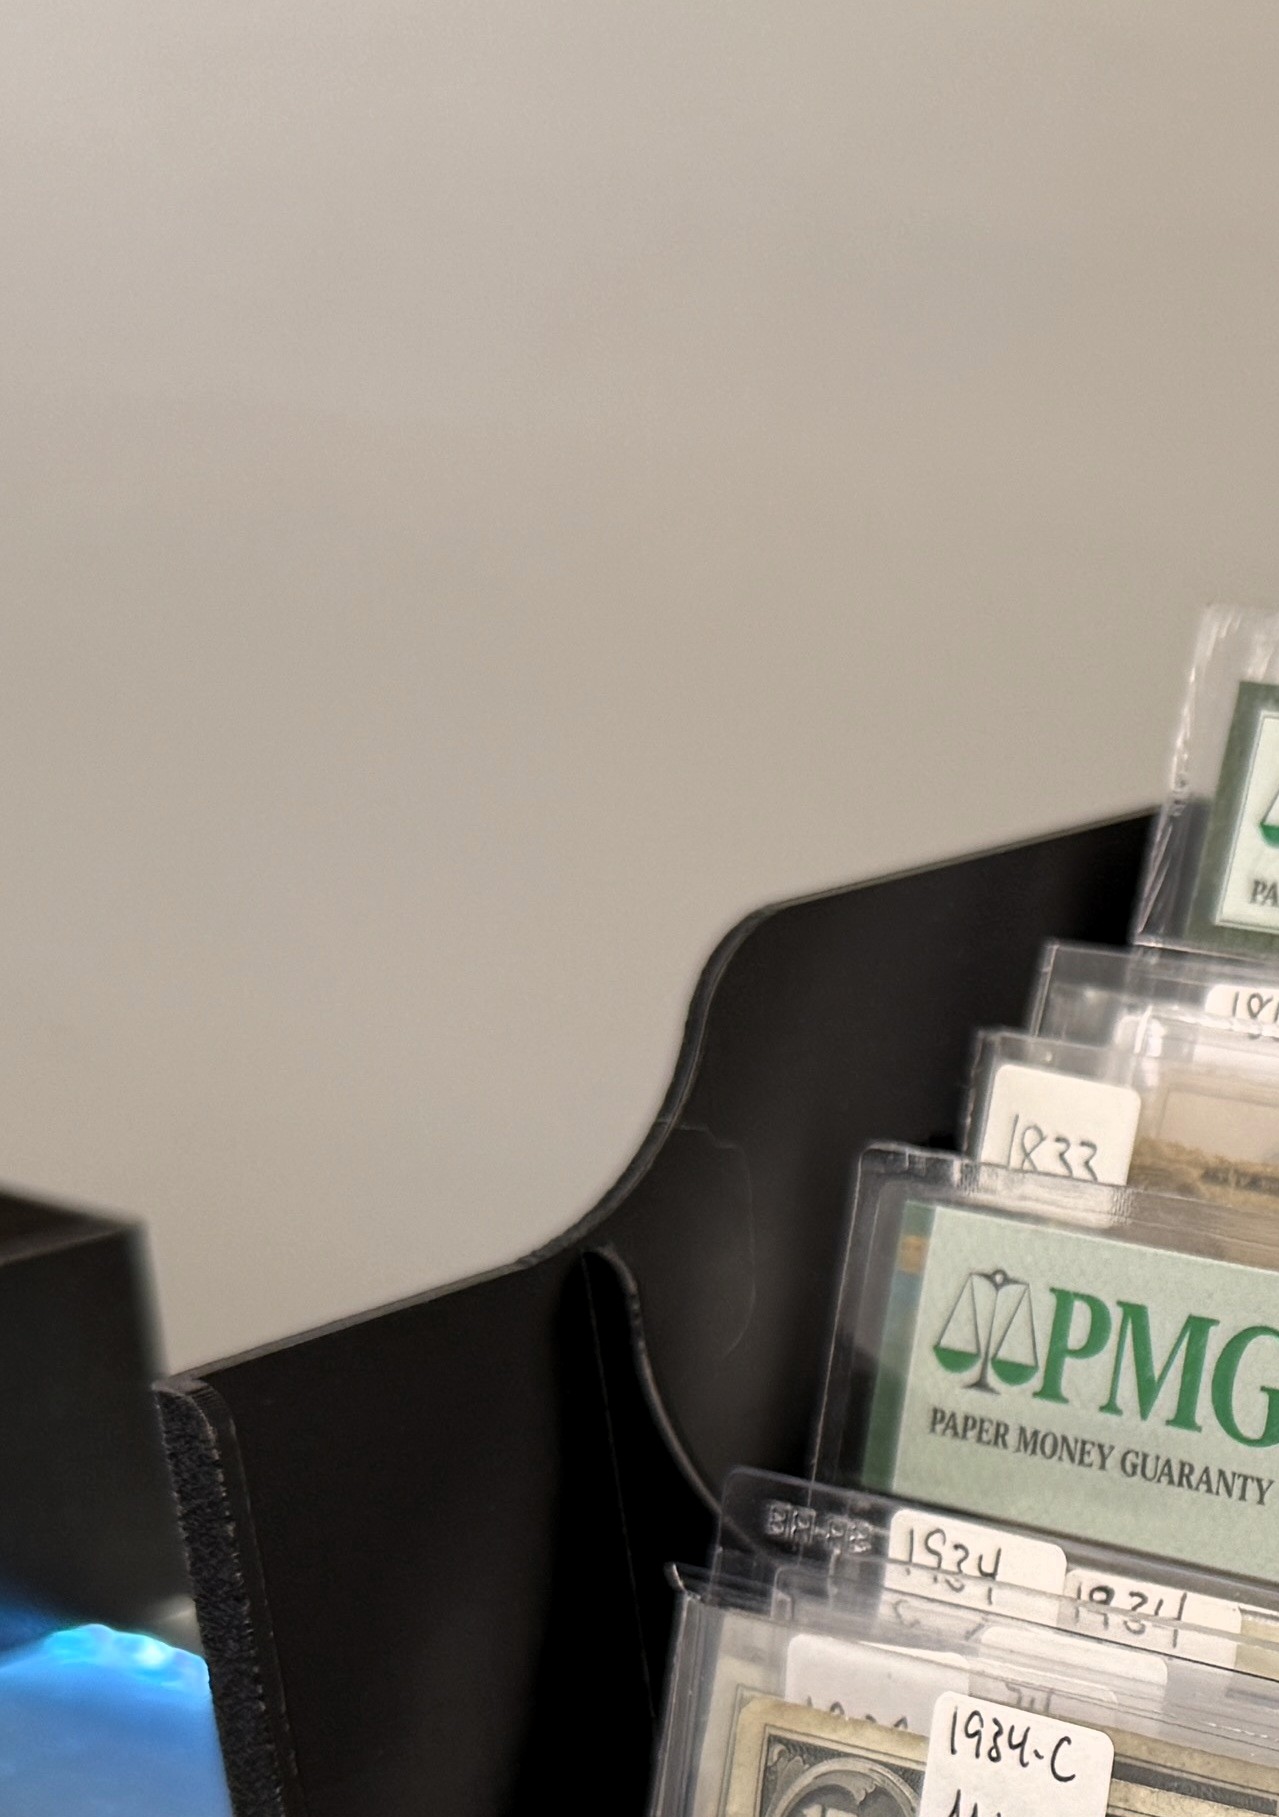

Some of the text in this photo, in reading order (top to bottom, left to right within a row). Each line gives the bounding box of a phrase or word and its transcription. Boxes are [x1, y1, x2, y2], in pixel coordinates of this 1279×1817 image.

[928, 1406, 1276, 1507] PAPER MONEY GUARANTY
[950, 1705, 1077, 1784] 1934-C
